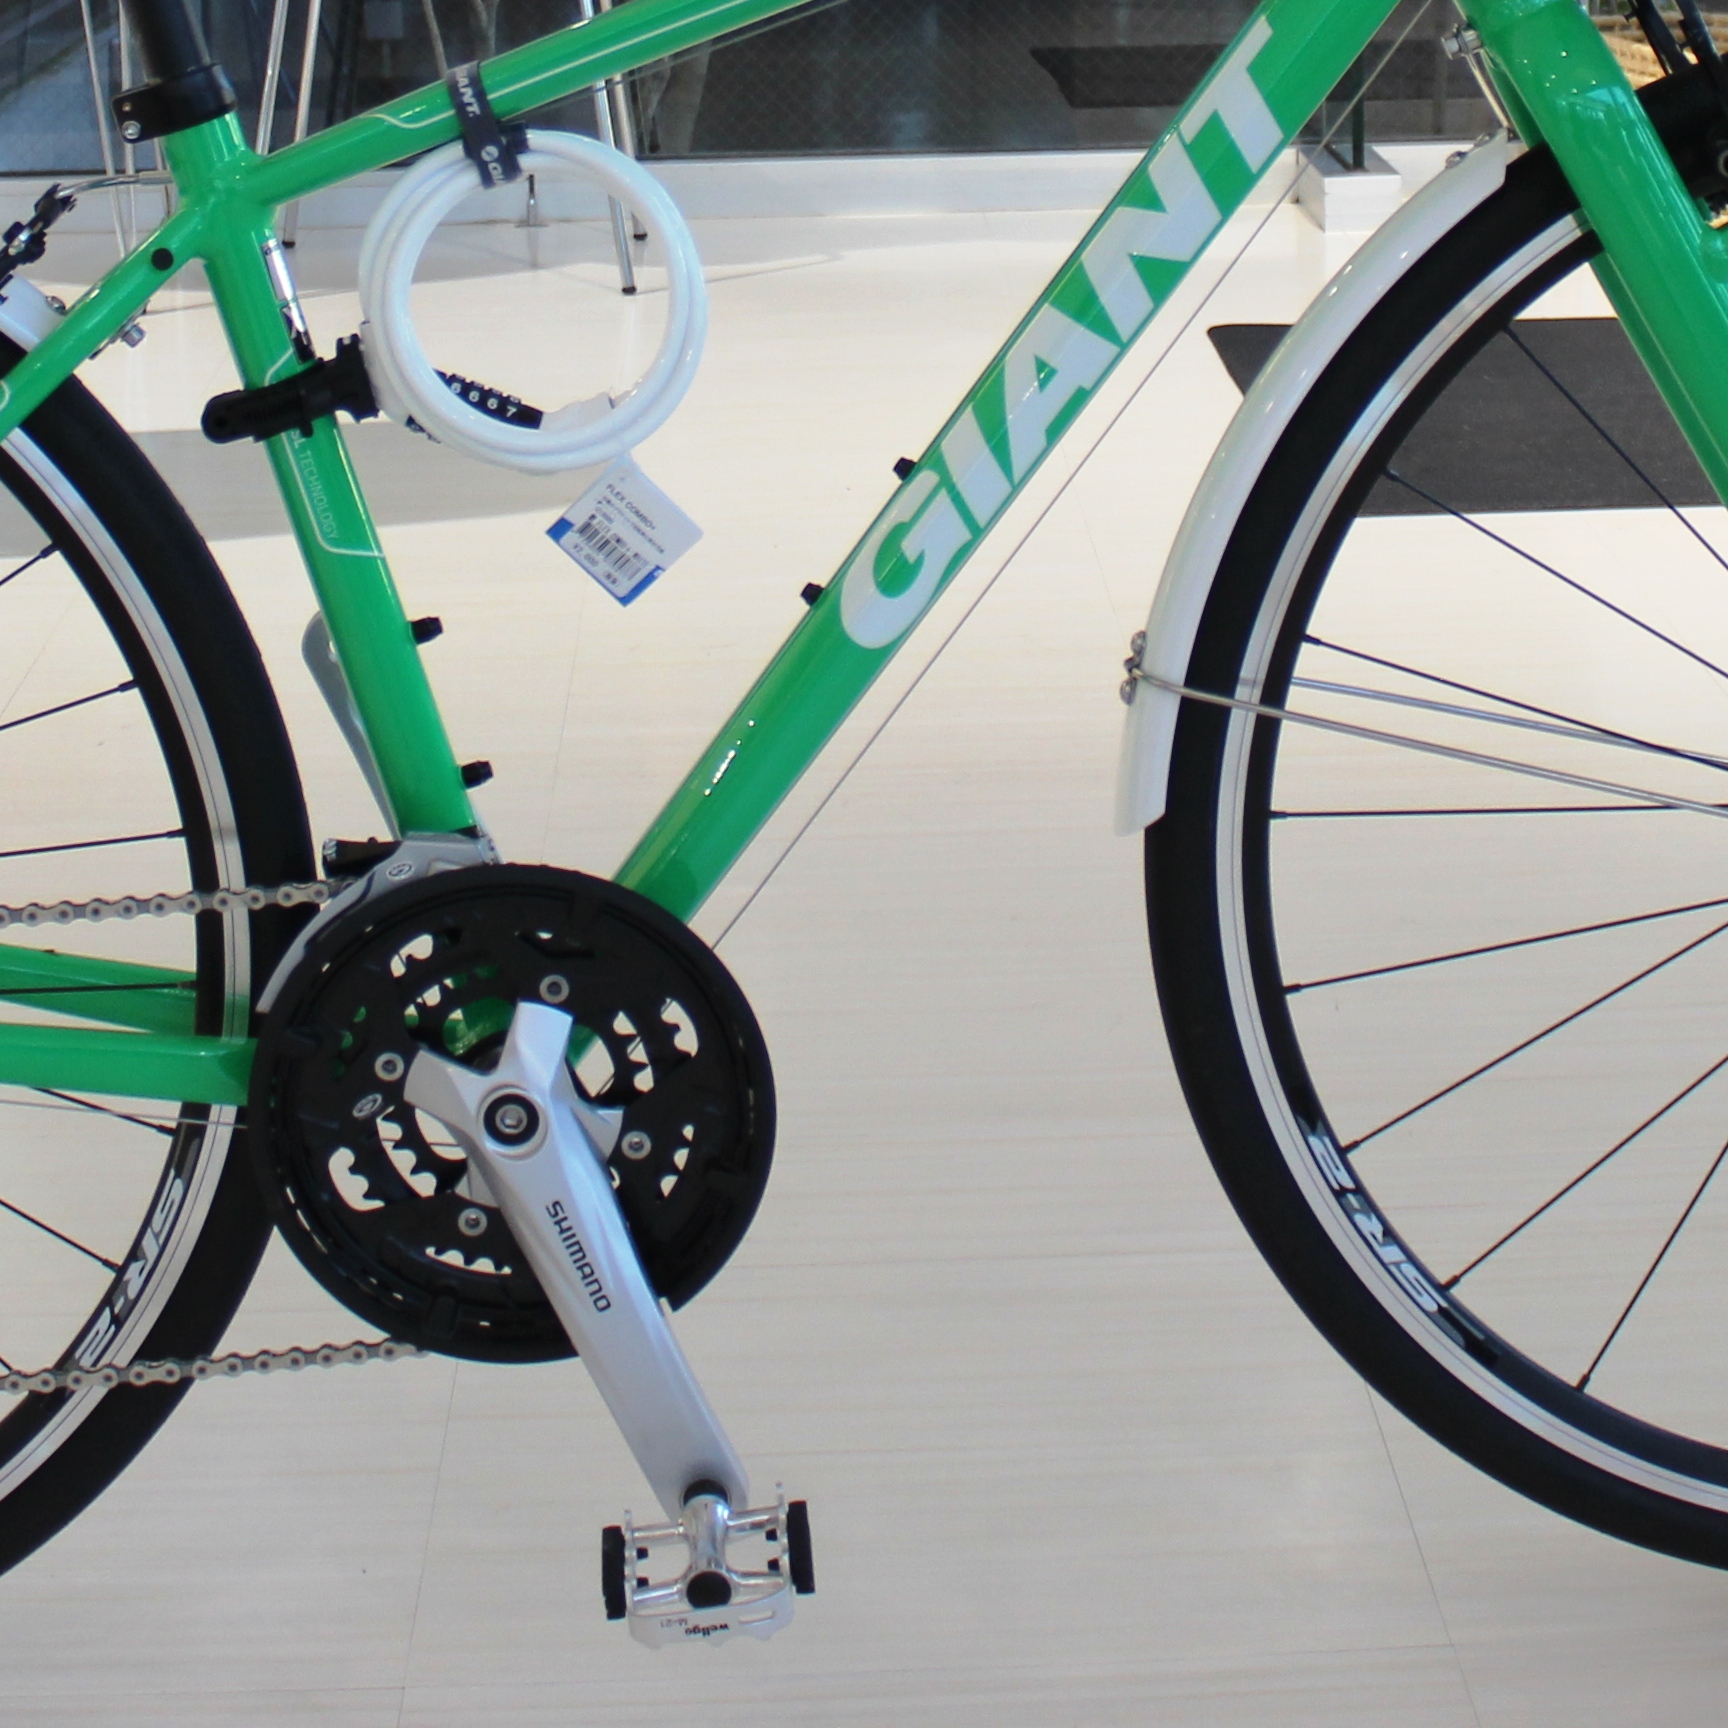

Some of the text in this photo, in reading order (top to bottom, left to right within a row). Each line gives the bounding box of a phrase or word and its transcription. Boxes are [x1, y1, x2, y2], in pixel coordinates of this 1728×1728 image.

[839, 15, 1285, 649] GIANT
[297, 450, 339, 540] TECHNOLOGY
[543, 1199, 611, 1315] SHIMANO
